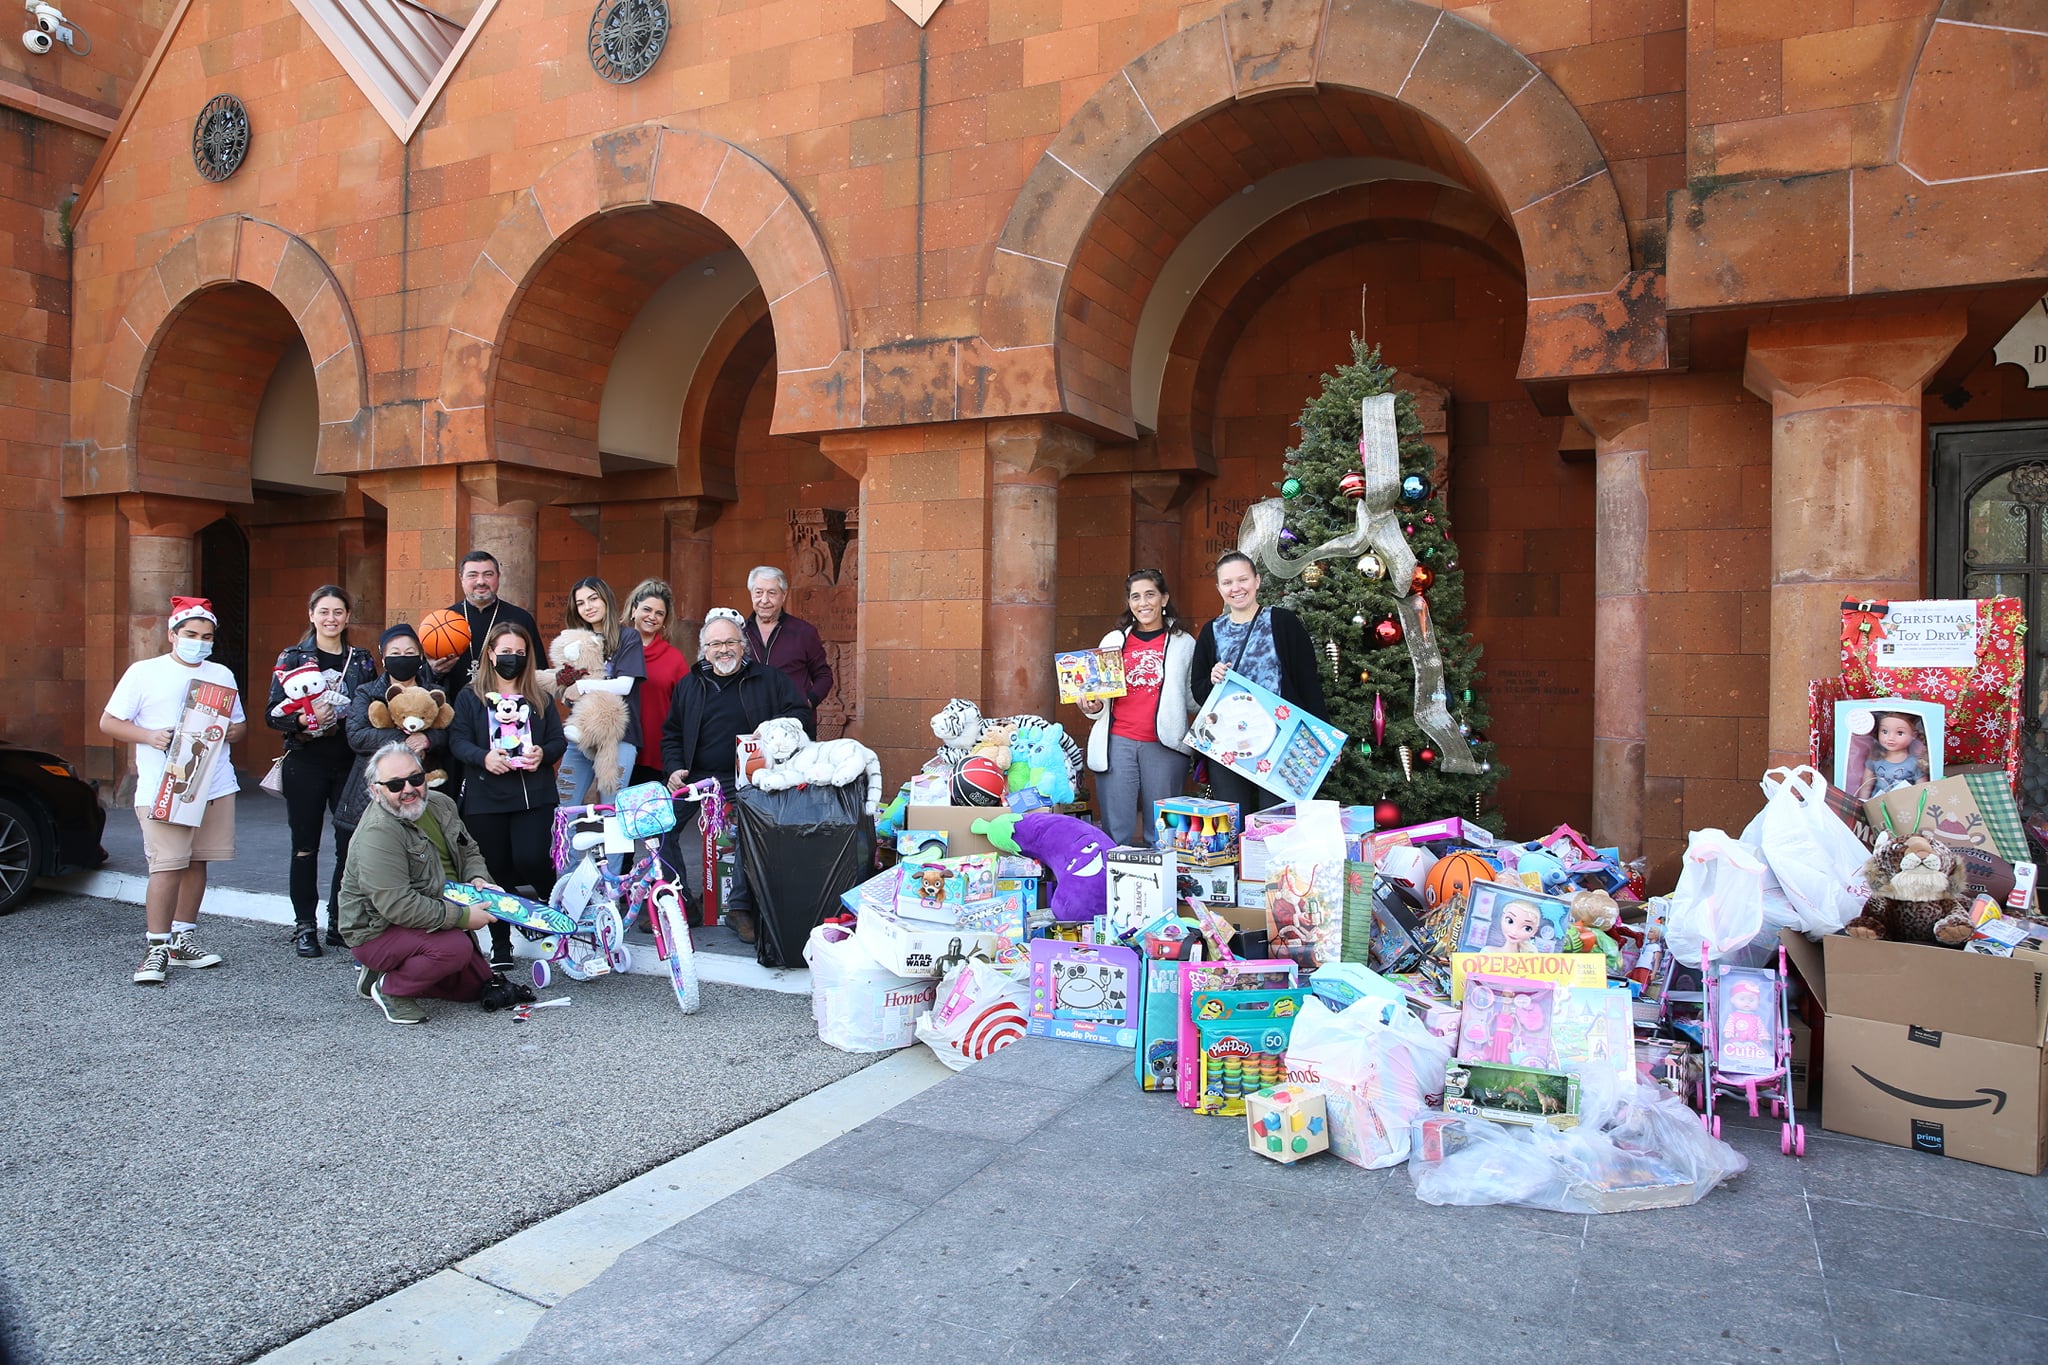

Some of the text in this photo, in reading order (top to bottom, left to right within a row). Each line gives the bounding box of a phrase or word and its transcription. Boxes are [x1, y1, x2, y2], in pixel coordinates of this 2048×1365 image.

[1891, 612, 1972, 624] CHRISTMAS
[1895, 629, 1921, 641] TOY
[159, 775, 176, 809] Razor
[959, 904, 1007, 924] CONNECT
[906, 953, 933, 961] STAR
[1462, 954, 1575, 975] OPERATION
[1055, 1028, 1082, 1039] Doodle
[1084, 1031, 1098, 1041] Pro
[1265, 1036, 1282, 1047] 50
[1723, 1043, 1766, 1058] Cutie
[1449, 1104, 1478, 1116] WORLD
[1916, 1133, 1942, 1143] prime
